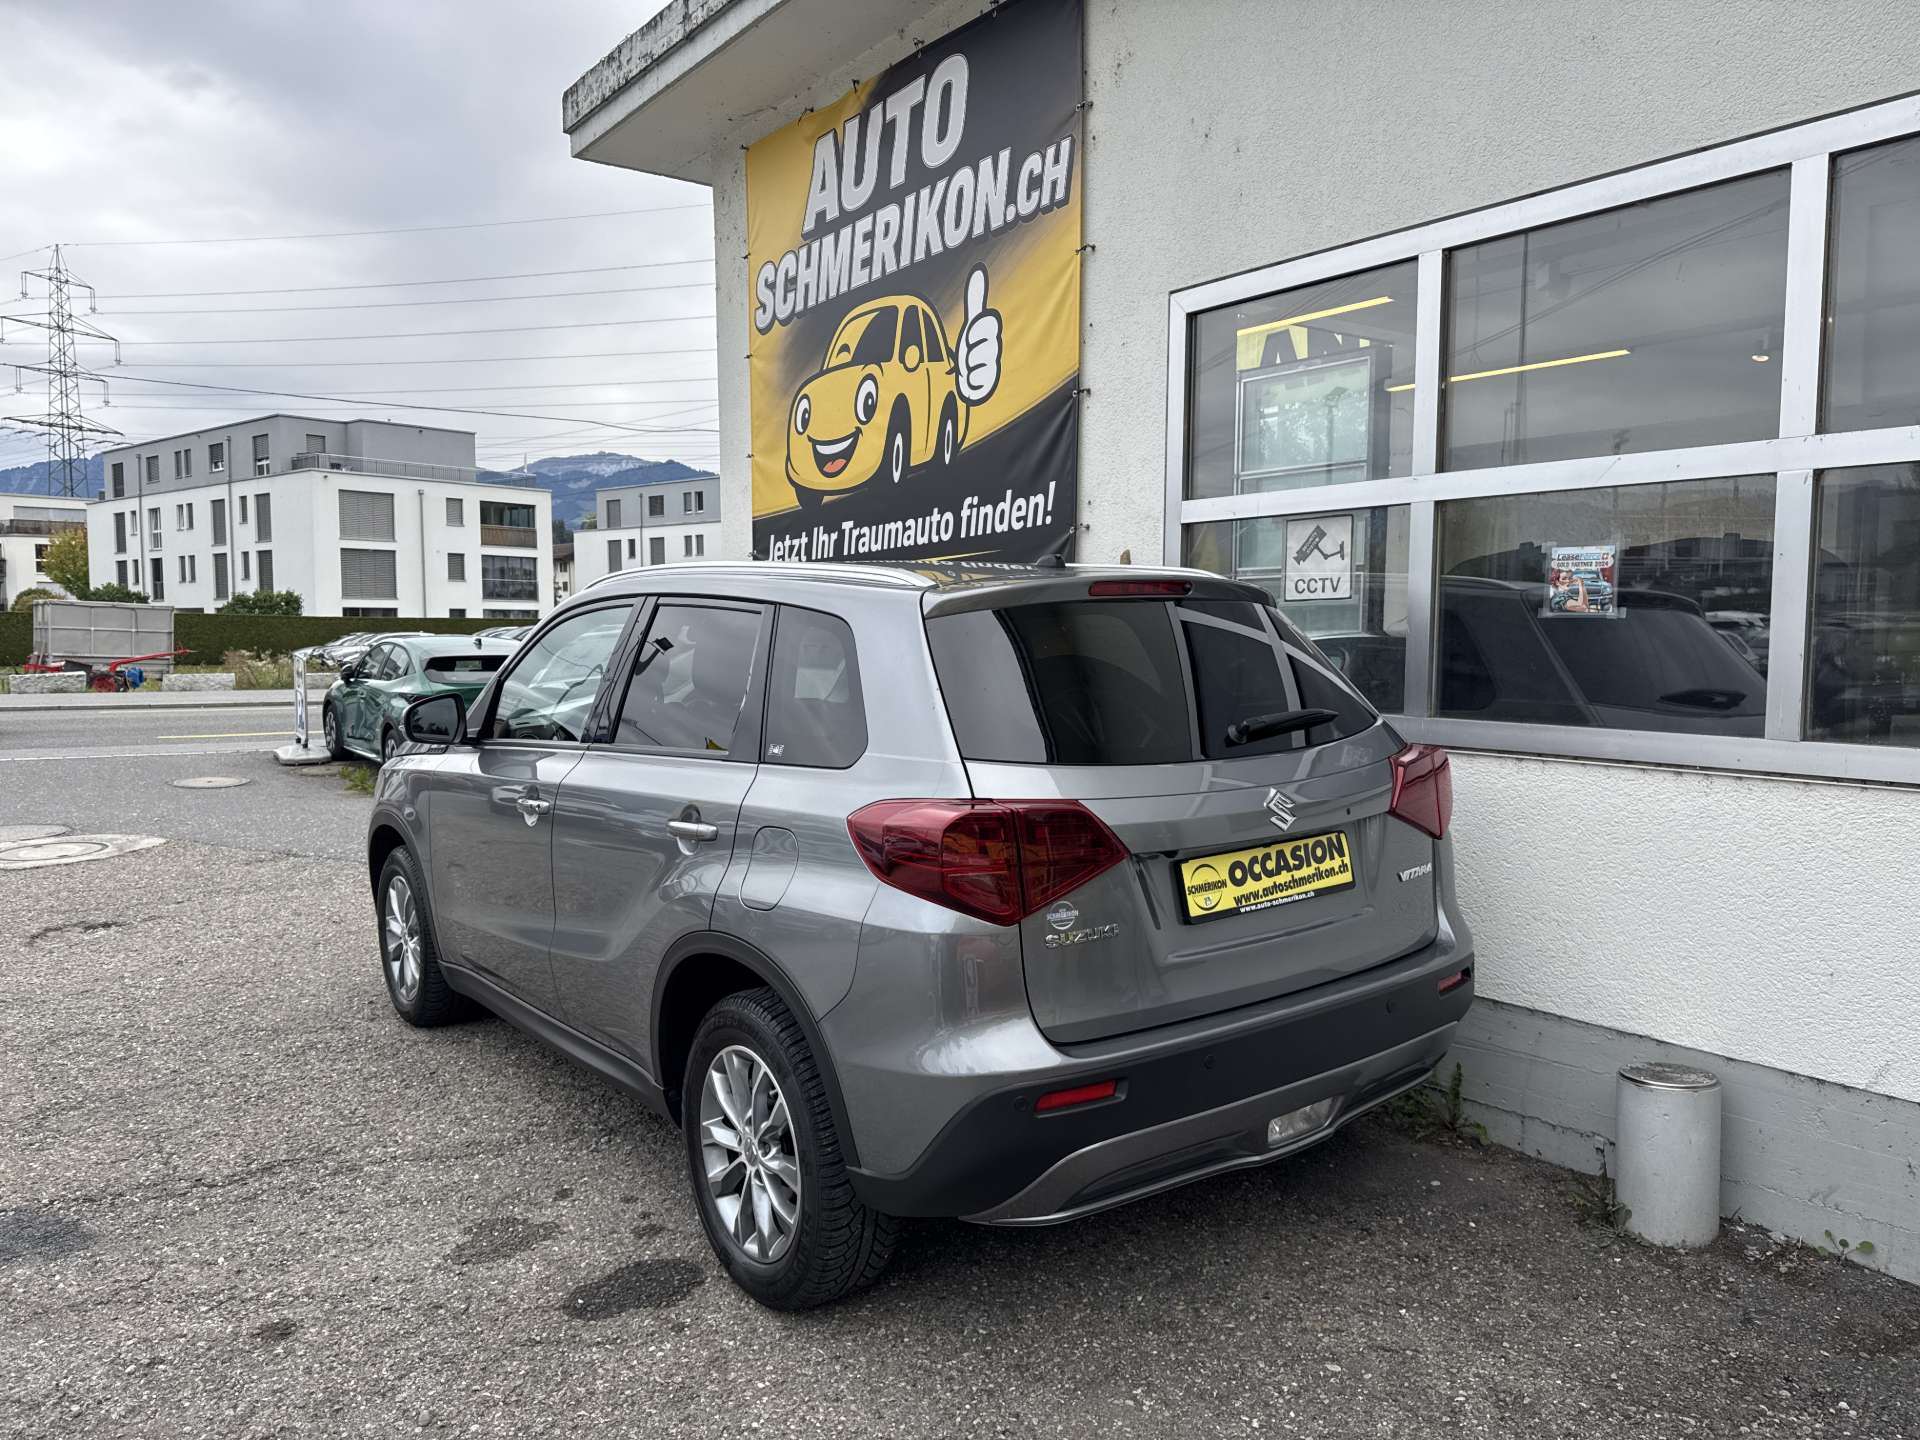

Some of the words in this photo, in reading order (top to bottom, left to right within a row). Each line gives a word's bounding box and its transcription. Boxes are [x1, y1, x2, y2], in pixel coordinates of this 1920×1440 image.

[802, 53, 969, 235] AUTO
[755, 137, 1074, 331] SCHMERIKON.CH
[768, 533, 808, 561] Jetzt
[811, 525, 838, 560] Ihr
[841, 507, 953, 557] Traumauto
[959, 480, 1057, 539] finden!
[1294, 576, 1341, 594] CCTV
[1228, 832, 1346, 887] OCCASION
[1187, 878, 1227, 896] SCHMERIKON
[1233, 861, 1349, 907] www.autoschmerikon.ch
[1239, 890, 1315, 913] www.auto-schmerikon.ch
[1045, 923, 1119, 948] SUZUKI
